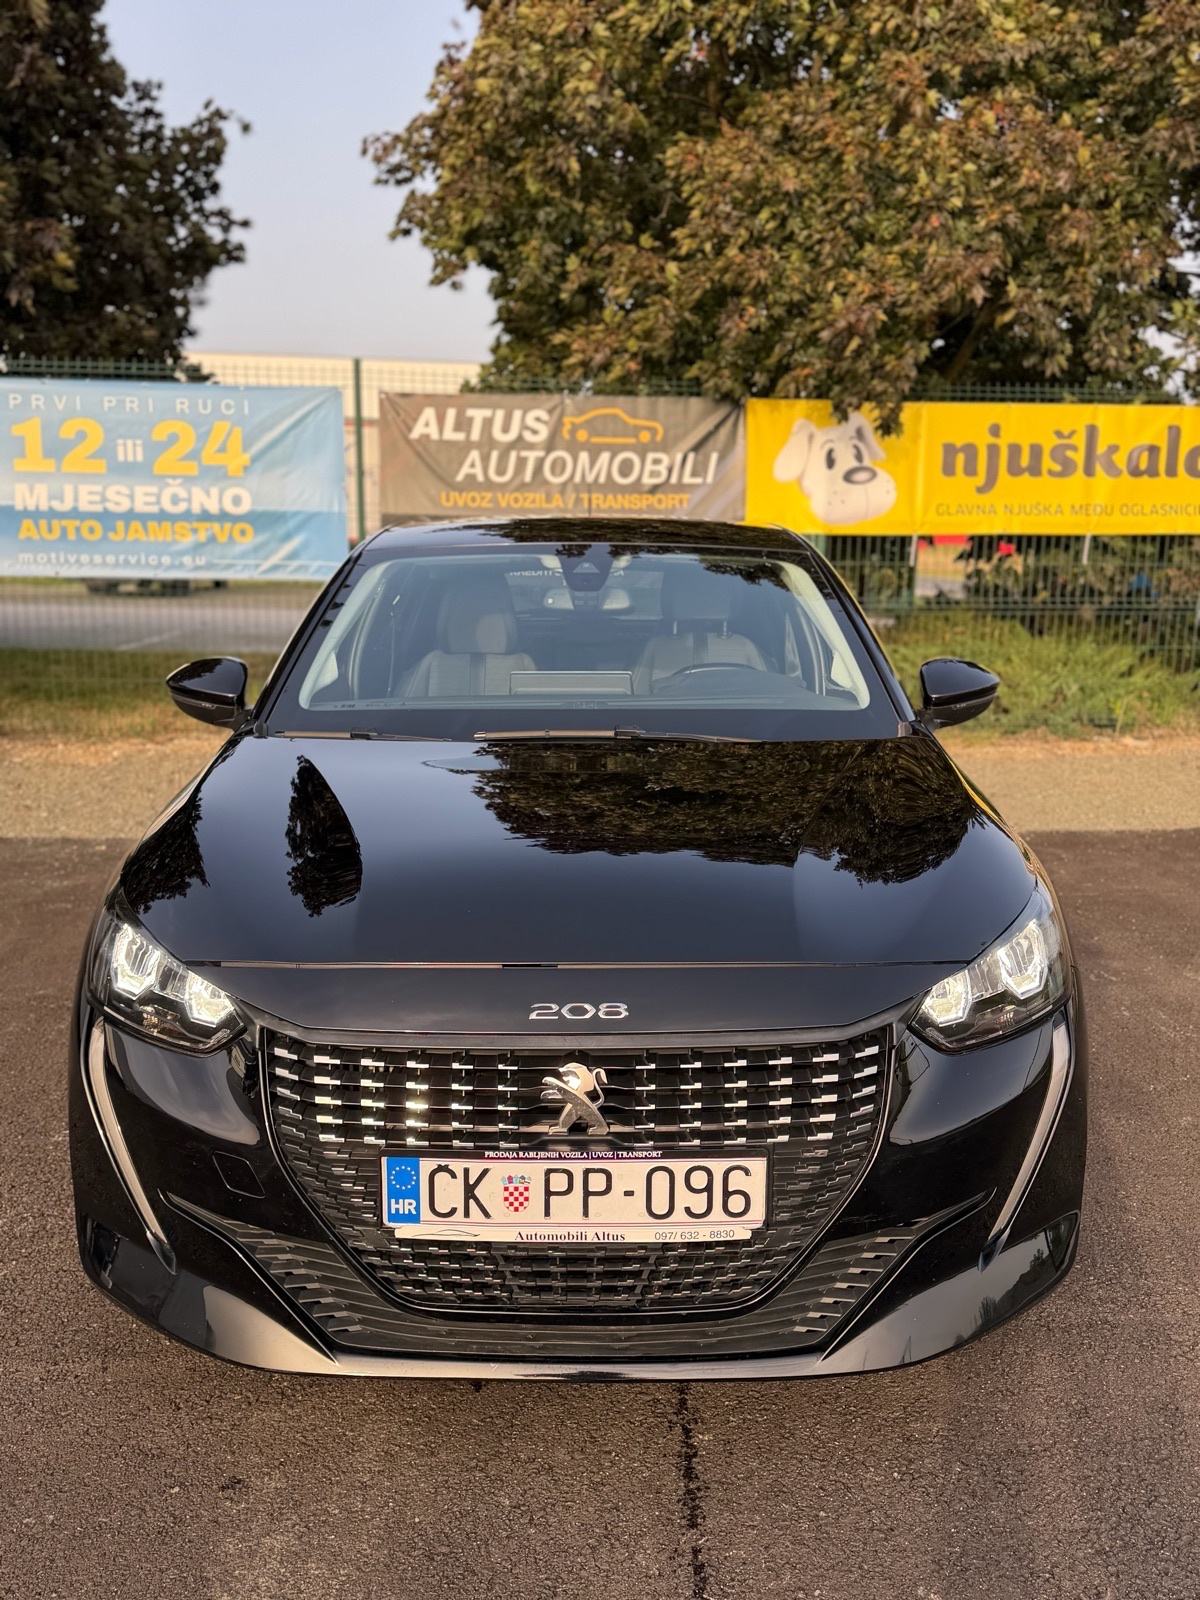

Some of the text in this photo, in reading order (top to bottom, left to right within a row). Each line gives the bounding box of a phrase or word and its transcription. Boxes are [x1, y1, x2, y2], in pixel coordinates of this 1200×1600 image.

[8, 393, 250, 416] PRVI PRI RUCI
[409, 406, 550, 443] ALTUS
[10, 415, 250, 478] 12 ili 24
[455, 449, 719, 486] AUTOMOBILI
[14, 478, 252, 515] MJESEČNO
[440, 493, 494, 508] UVOZ
[497, 493, 564, 509] VOZILA
[580, 494, 691, 510] TRANSPORT
[936, 503, 997, 517] GLAVNA
[1004, 499, 1064, 517] NJUŠKA
[1119, 503, 1200, 518] OGLASNICI
[18, 519, 255, 544] AUTO JAMSTVO
[18, 552, 207, 566] motiveservice.eu
[529, 1002, 629, 1020] 208
[618, 1150, 662, 1158] TRANSPORT
[428, 1164, 752, 1220] ČK PP-096
[391, 1199, 416, 1215] HR
[514, 1231, 626, 1241] Automobili Altus
[654, 1231, 678, 1242] 097/
[680, 1231, 699, 1240] 632
[709, 1229, 735, 1240] 8830
